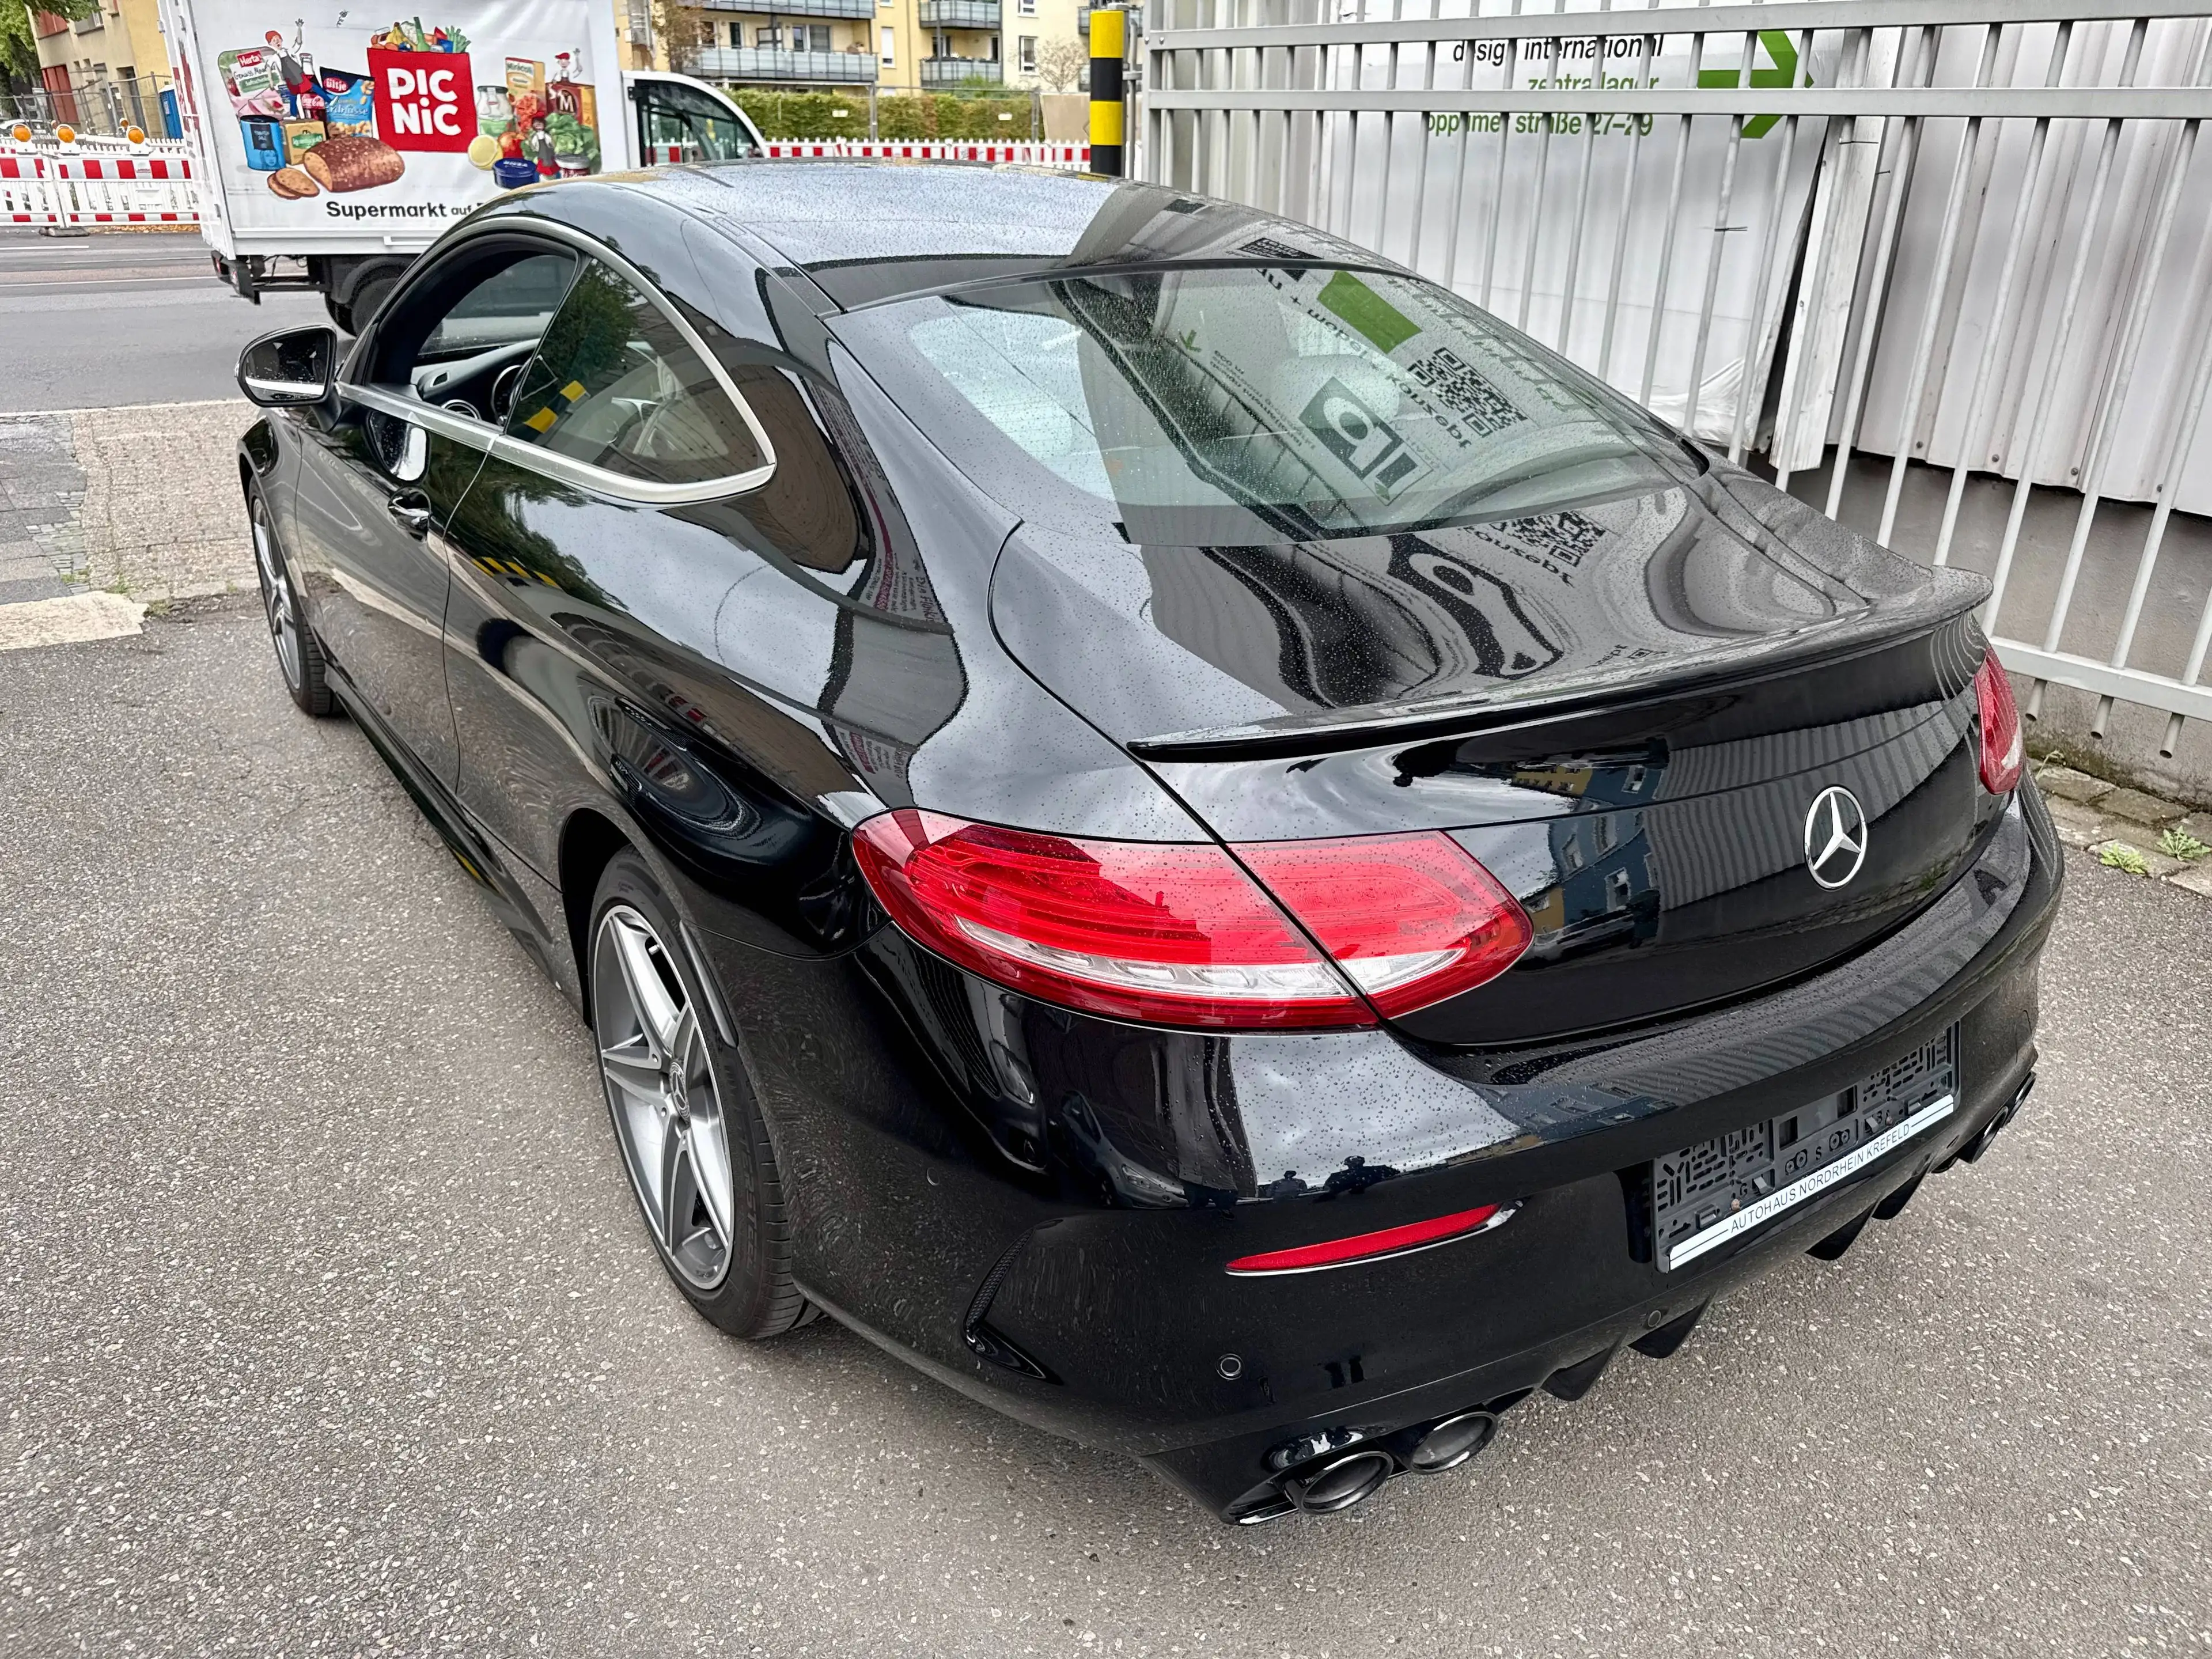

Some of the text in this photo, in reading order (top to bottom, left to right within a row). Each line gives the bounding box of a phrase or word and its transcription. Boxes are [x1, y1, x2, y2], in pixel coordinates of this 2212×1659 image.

[1453, 40, 1512, 66] dsig
[326, 78, 347, 91] ültje
[387, 67, 458, 102] PIC
[326, 200, 448, 221] Supermarkt
[1730, 1123, 1910, 1234] AUTOHAUS NORDRHEIN KREFELD
